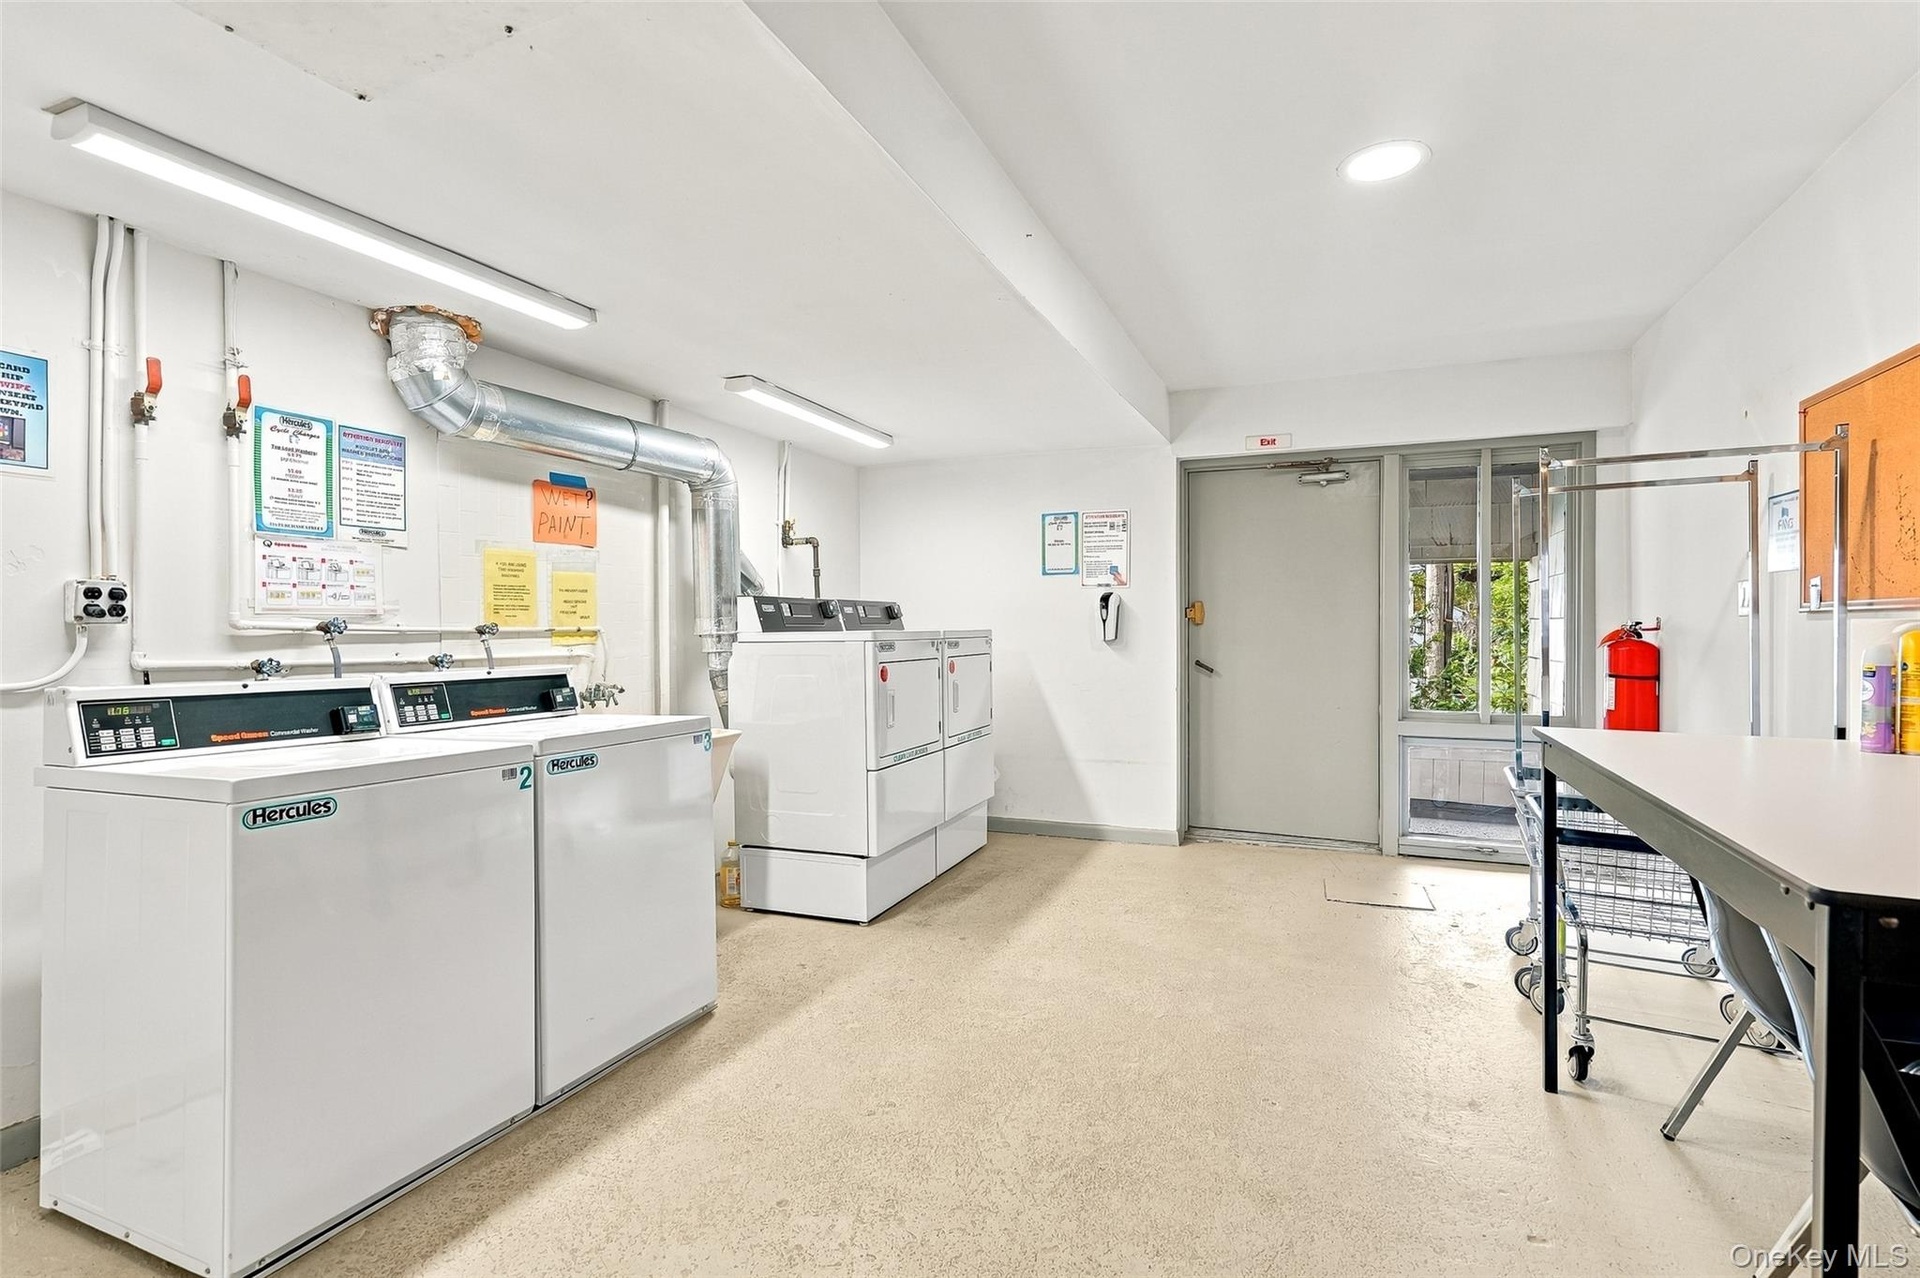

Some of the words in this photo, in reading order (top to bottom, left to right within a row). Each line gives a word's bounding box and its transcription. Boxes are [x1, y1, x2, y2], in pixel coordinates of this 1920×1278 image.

[281, 416, 312, 430] Hercules
[1260, 438, 1276, 446] Exit
[537, 511, 591, 540] PAINT.
[210, 732, 241, 743] Speed
[241, 731, 269, 740] Queen
[270, 729, 301, 737] Commercial
[704, 732, 712, 752] 3
[550, 754, 597, 772] Hercules
[519, 765, 533, 790] 2
[252, 800, 332, 825] Hercules
